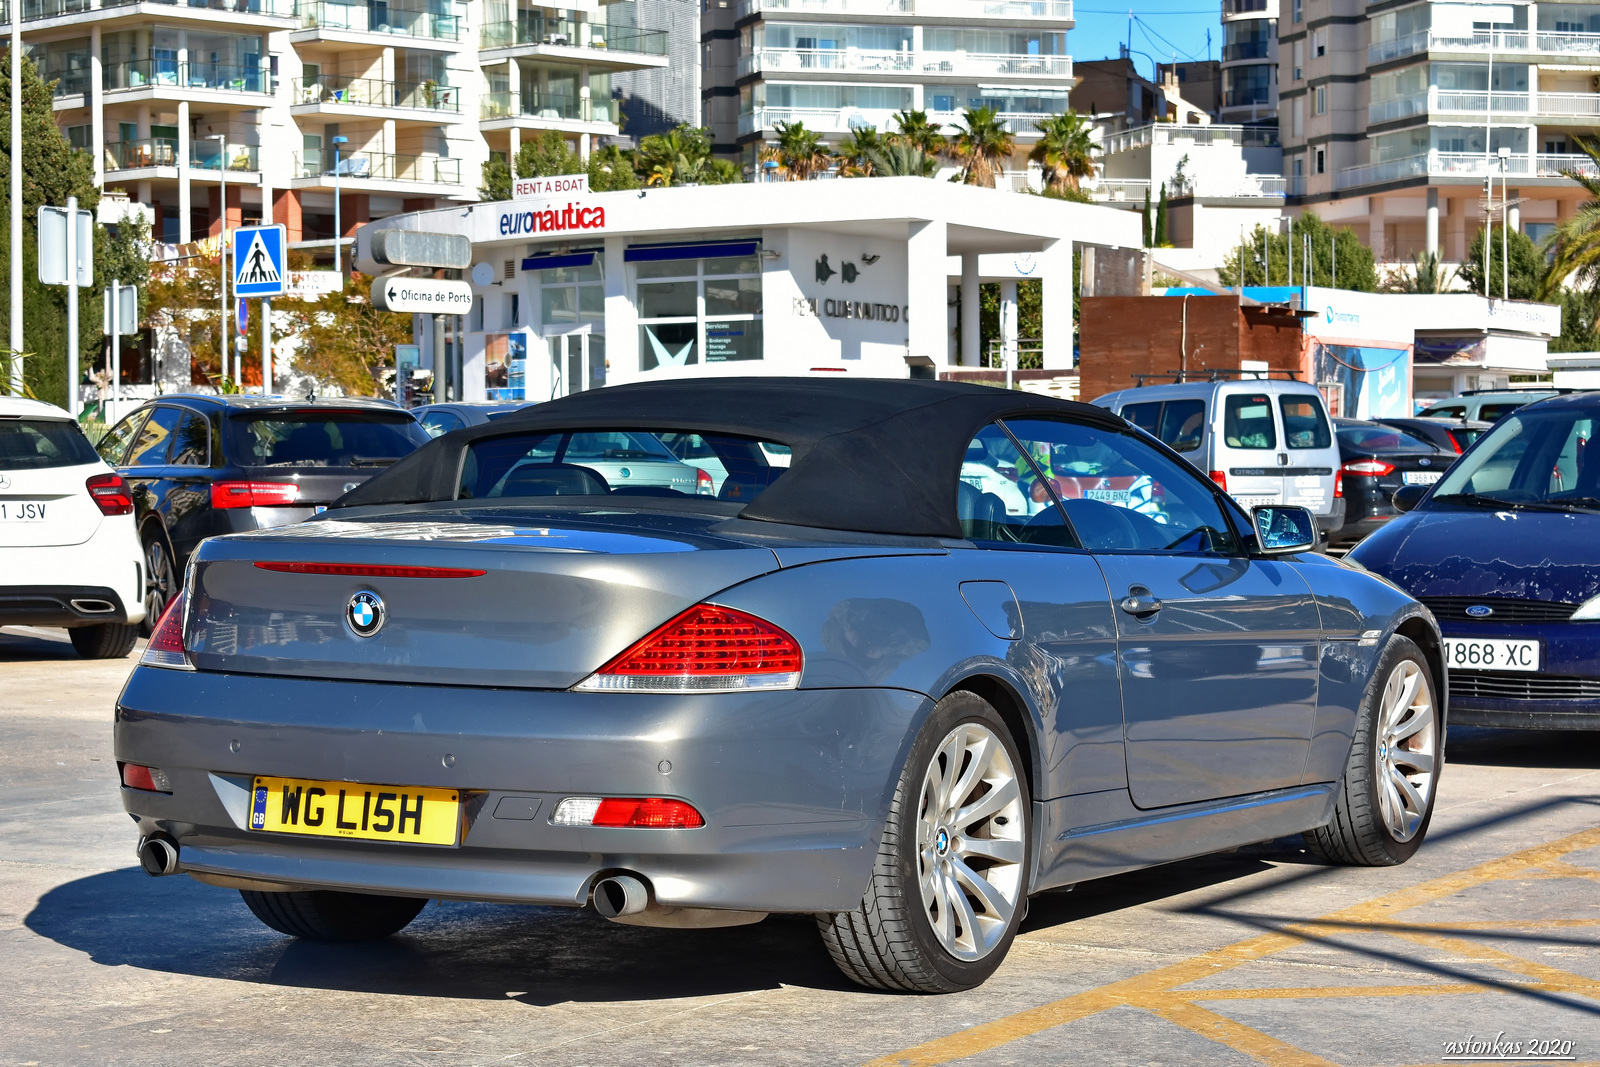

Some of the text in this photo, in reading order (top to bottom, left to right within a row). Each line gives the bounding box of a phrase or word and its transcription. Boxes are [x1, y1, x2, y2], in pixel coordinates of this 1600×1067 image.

[517, 179, 584, 195] RENT A BOAT
[500, 202, 605, 235] euronáutica
[401, 289, 471, 303] Oficina de Ports
[824, 298, 852, 319] CLUB
[1089, 491, 1129, 501] 2449 BNZ
[16, 504, 46, 519] JSV
[1444, 642, 1532, 666] 1868 XC
[281, 785, 326, 827] WG
[252, 812, 265, 825] GB
